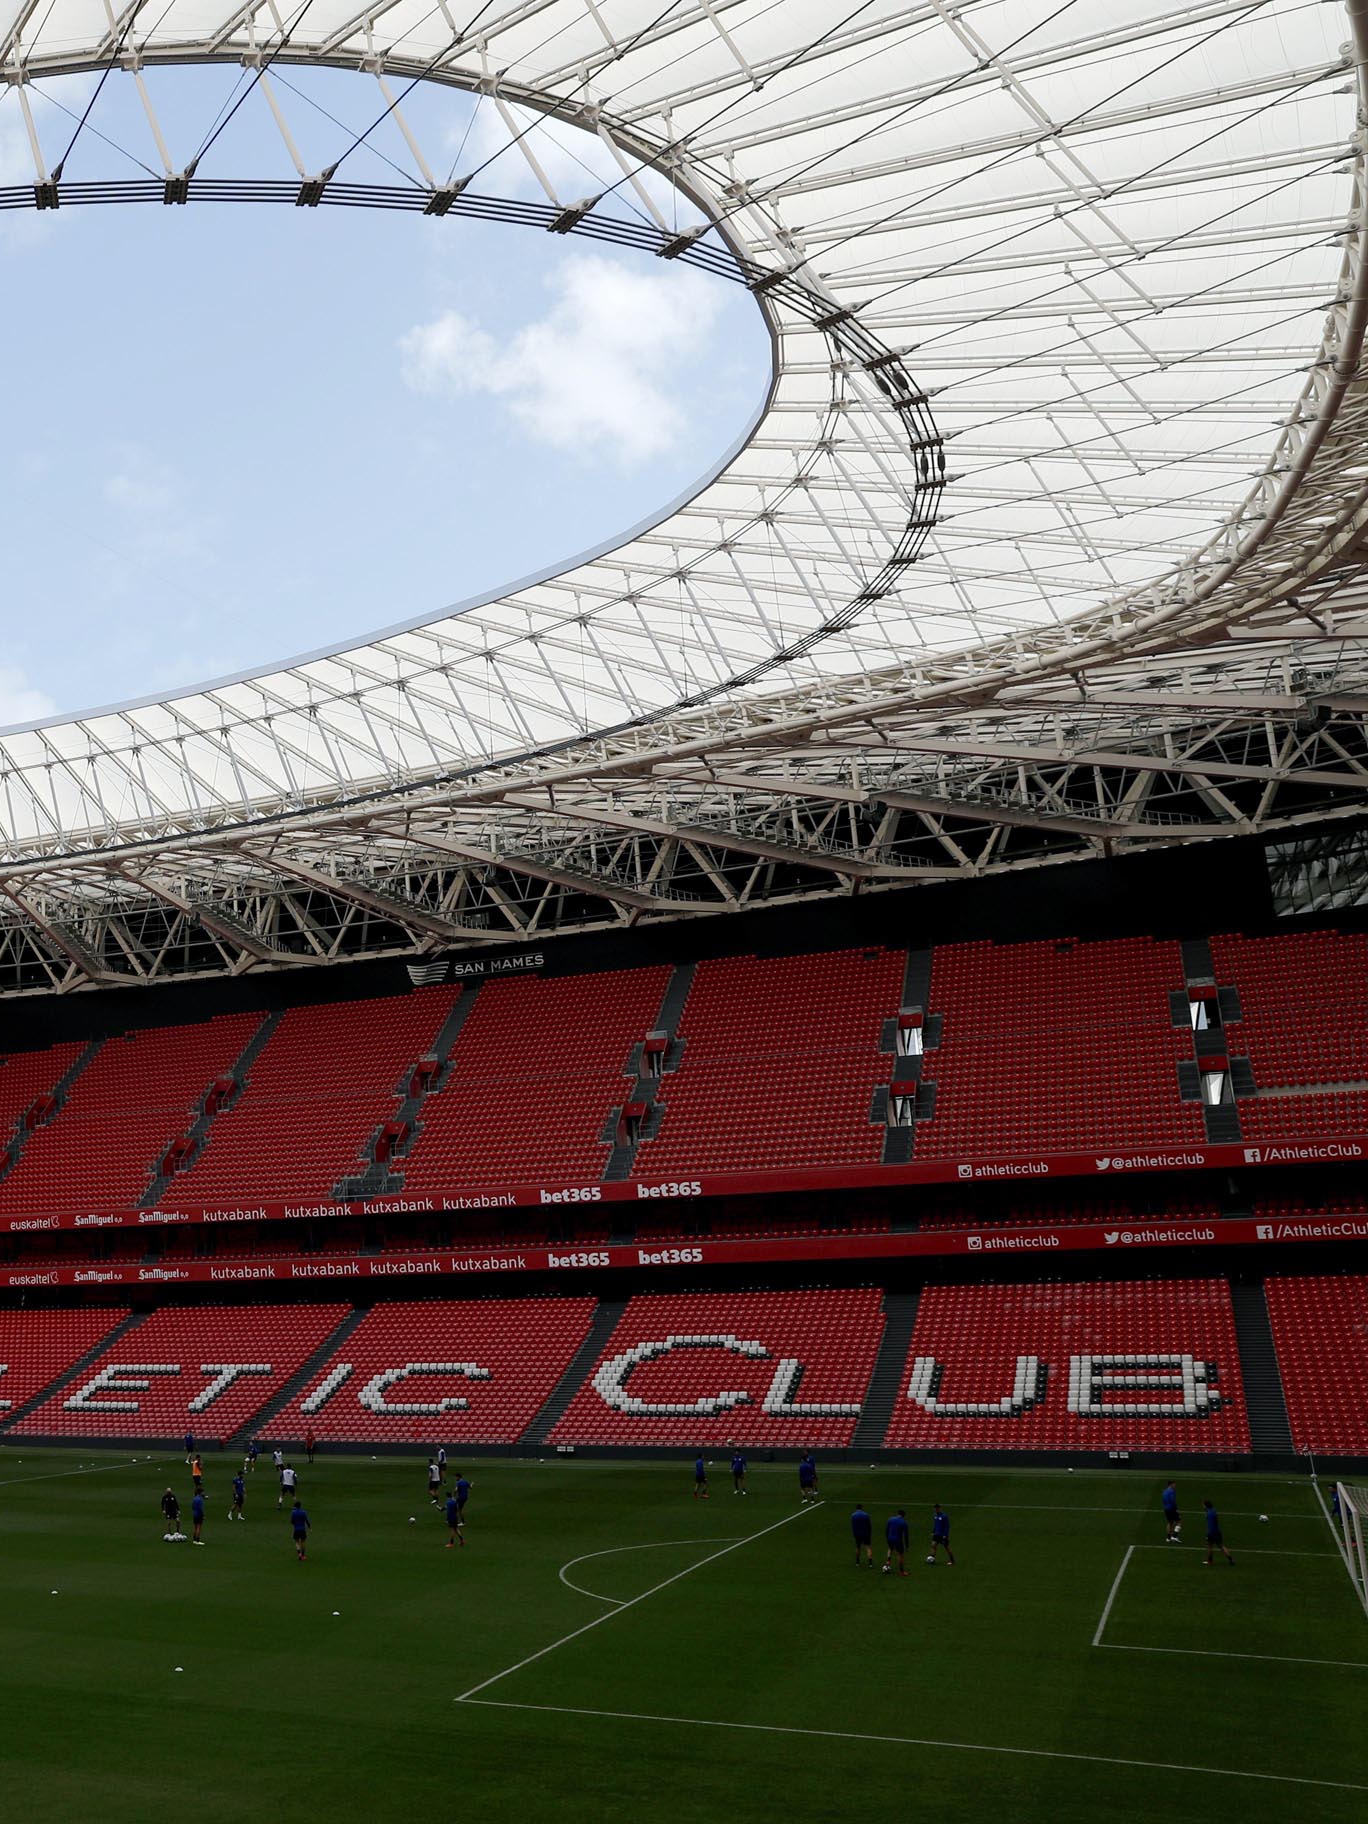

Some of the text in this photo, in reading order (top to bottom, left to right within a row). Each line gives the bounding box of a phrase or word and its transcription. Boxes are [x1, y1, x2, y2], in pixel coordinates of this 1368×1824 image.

[455, 955, 544, 976] SAN MAMES
[1112, 1152, 1205, 1170] @athleticclub
[975, 1161, 1048, 1177] athleticclub
[540, 1186, 601, 1204] bet365
[638, 1180, 701, 1198] bet365
[364, 1198, 433, 1214] kutxabank
[443, 1193, 516, 1209] kutxabank
[203, 1206, 266, 1221] kutxabank
[285, 1202, 351, 1217] kutxabank
[11, 1218, 50, 1230] euskaltel
[1277, 1223, 1368, 1238] /AthleticClu
[985, 1235, 1059, 1248] athleticclub
[1121, 1229, 1214, 1243] @athleticclub
[452, 1256, 526, 1270] kutxabank
[548, 1251, 610, 1268] bet365
[638, 1247, 703, 1264] bet365
[211, 1265, 275, 1278] kutxabank
[292, 1262, 359, 1276] kutxabank
[371, 1259, 440, 1274] kutxabank
[9, 1274, 49, 1285] euskaltel
[591, 1334, 1231, 1418] CLUB
